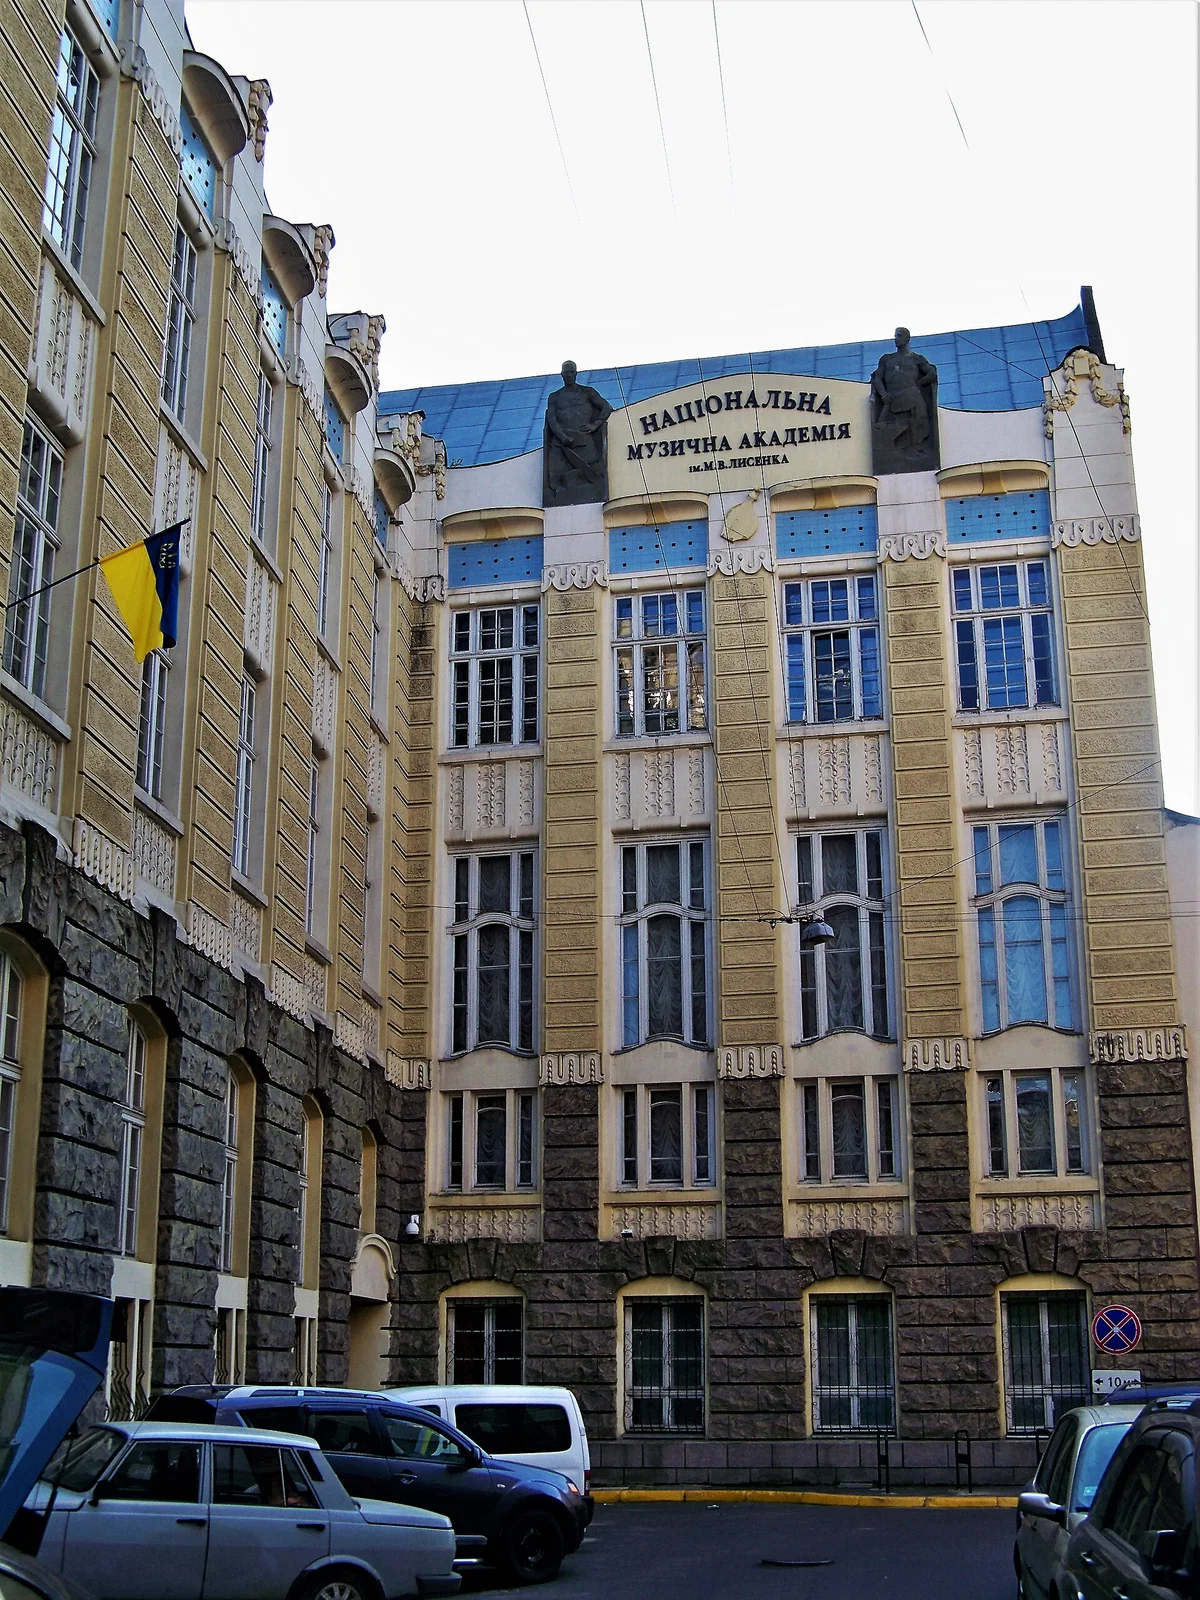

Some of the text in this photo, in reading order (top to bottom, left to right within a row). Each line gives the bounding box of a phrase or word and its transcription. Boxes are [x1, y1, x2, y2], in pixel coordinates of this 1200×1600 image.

[639, 389, 832, 436] НАЦІОНАЛЬНА
[626, 422, 852, 461] МУЗИЧНА АКАДЕМІЯ
